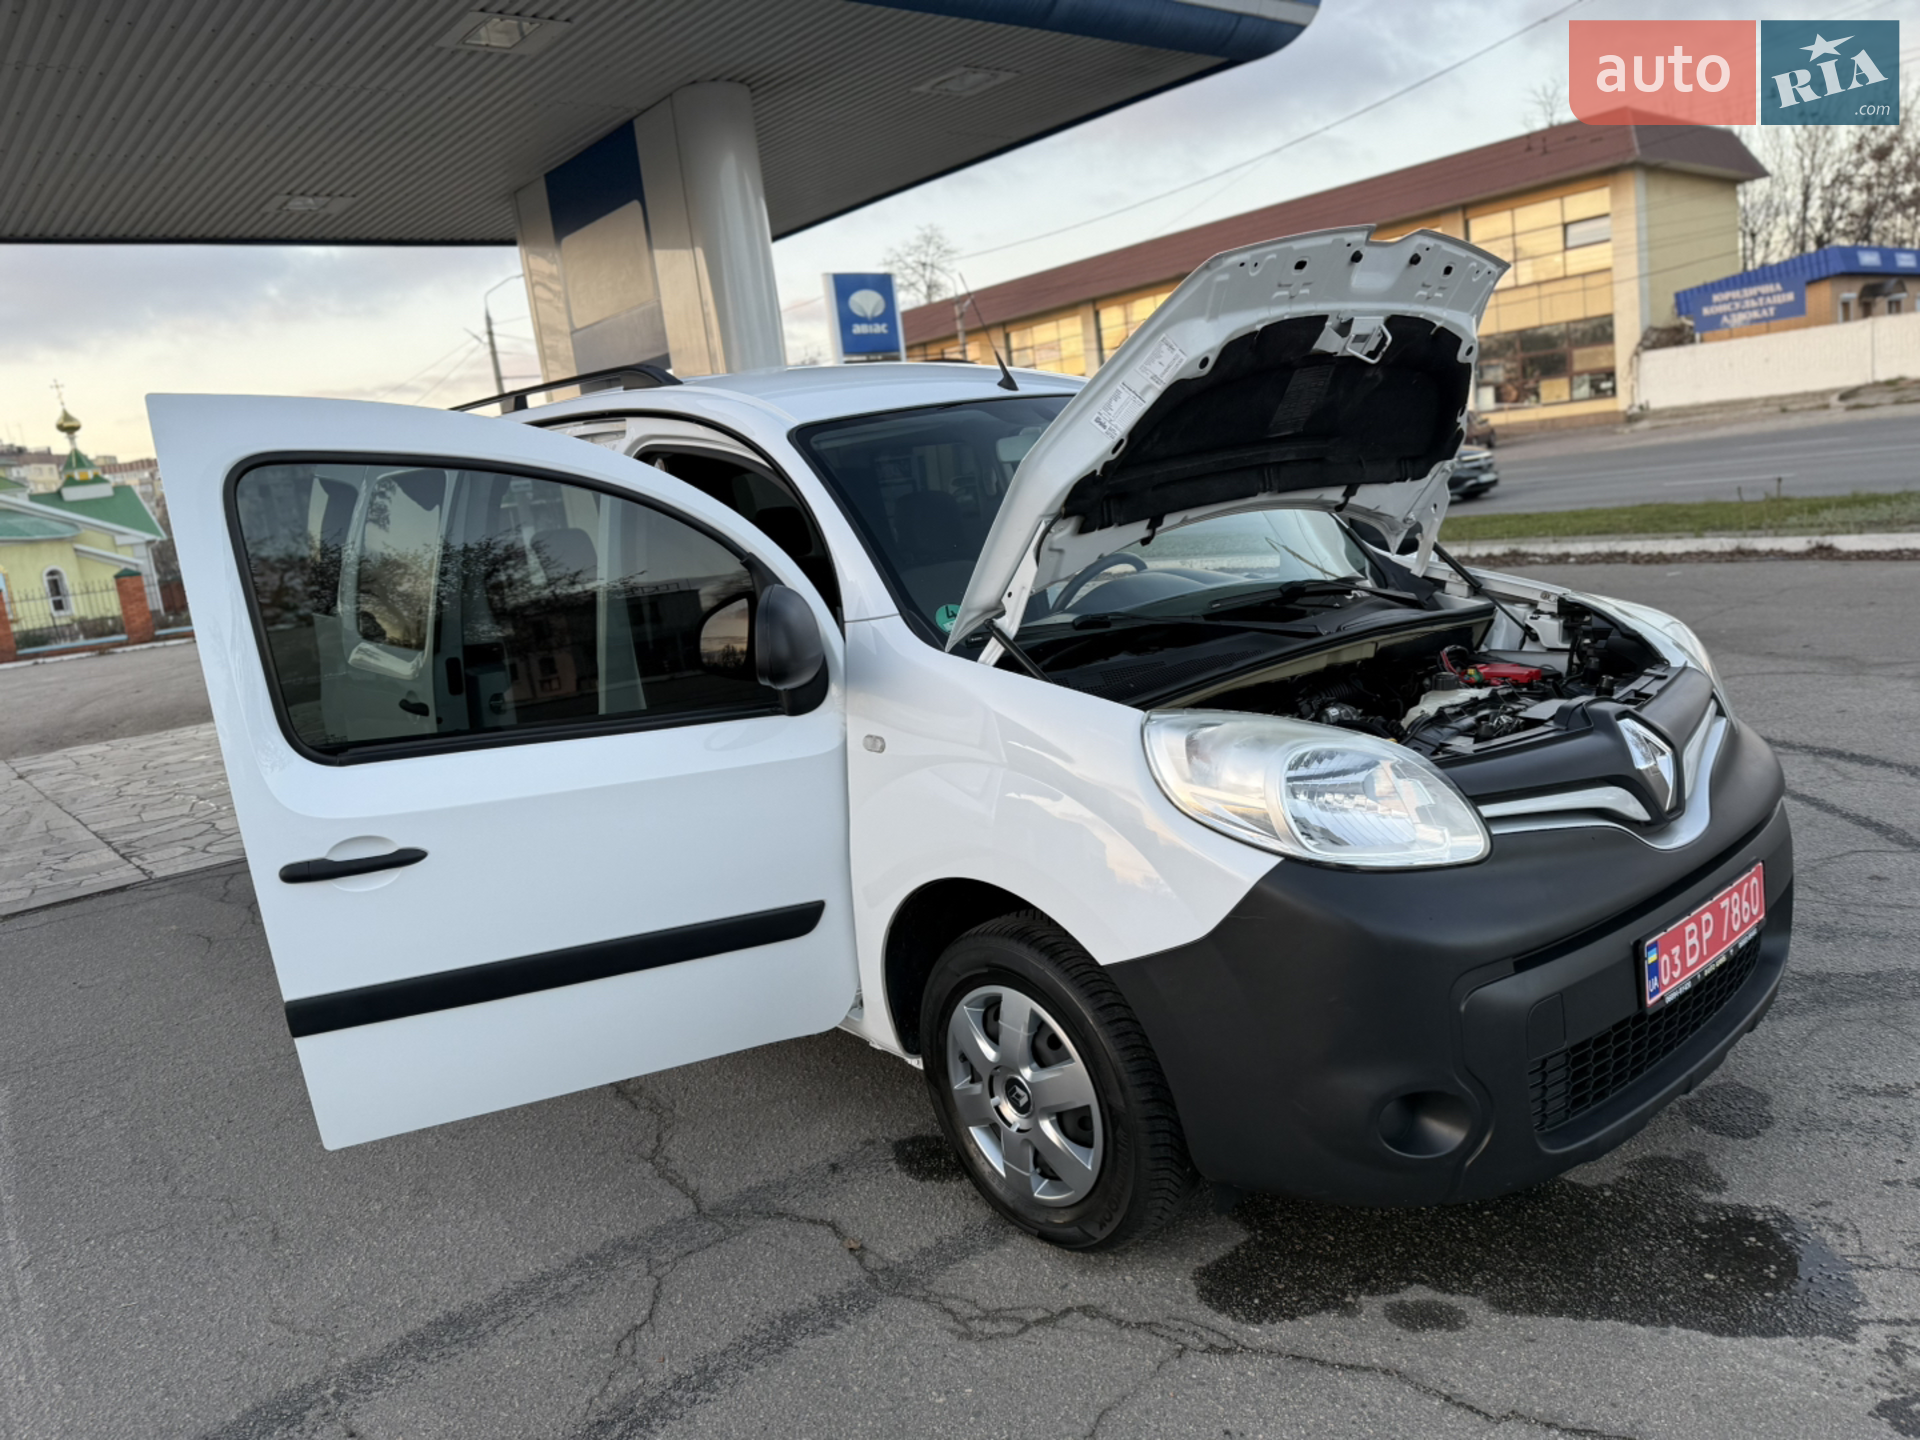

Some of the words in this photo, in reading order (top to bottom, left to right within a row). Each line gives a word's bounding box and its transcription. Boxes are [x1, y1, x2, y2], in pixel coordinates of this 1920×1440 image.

[1721, 307, 1776, 325] АДВОКАТ
[1661, 945, 1681, 985] 03
[1685, 912, 1714, 968] BP
[1720, 877, 1759, 941] 7860
[1649, 976, 1659, 992] UA
